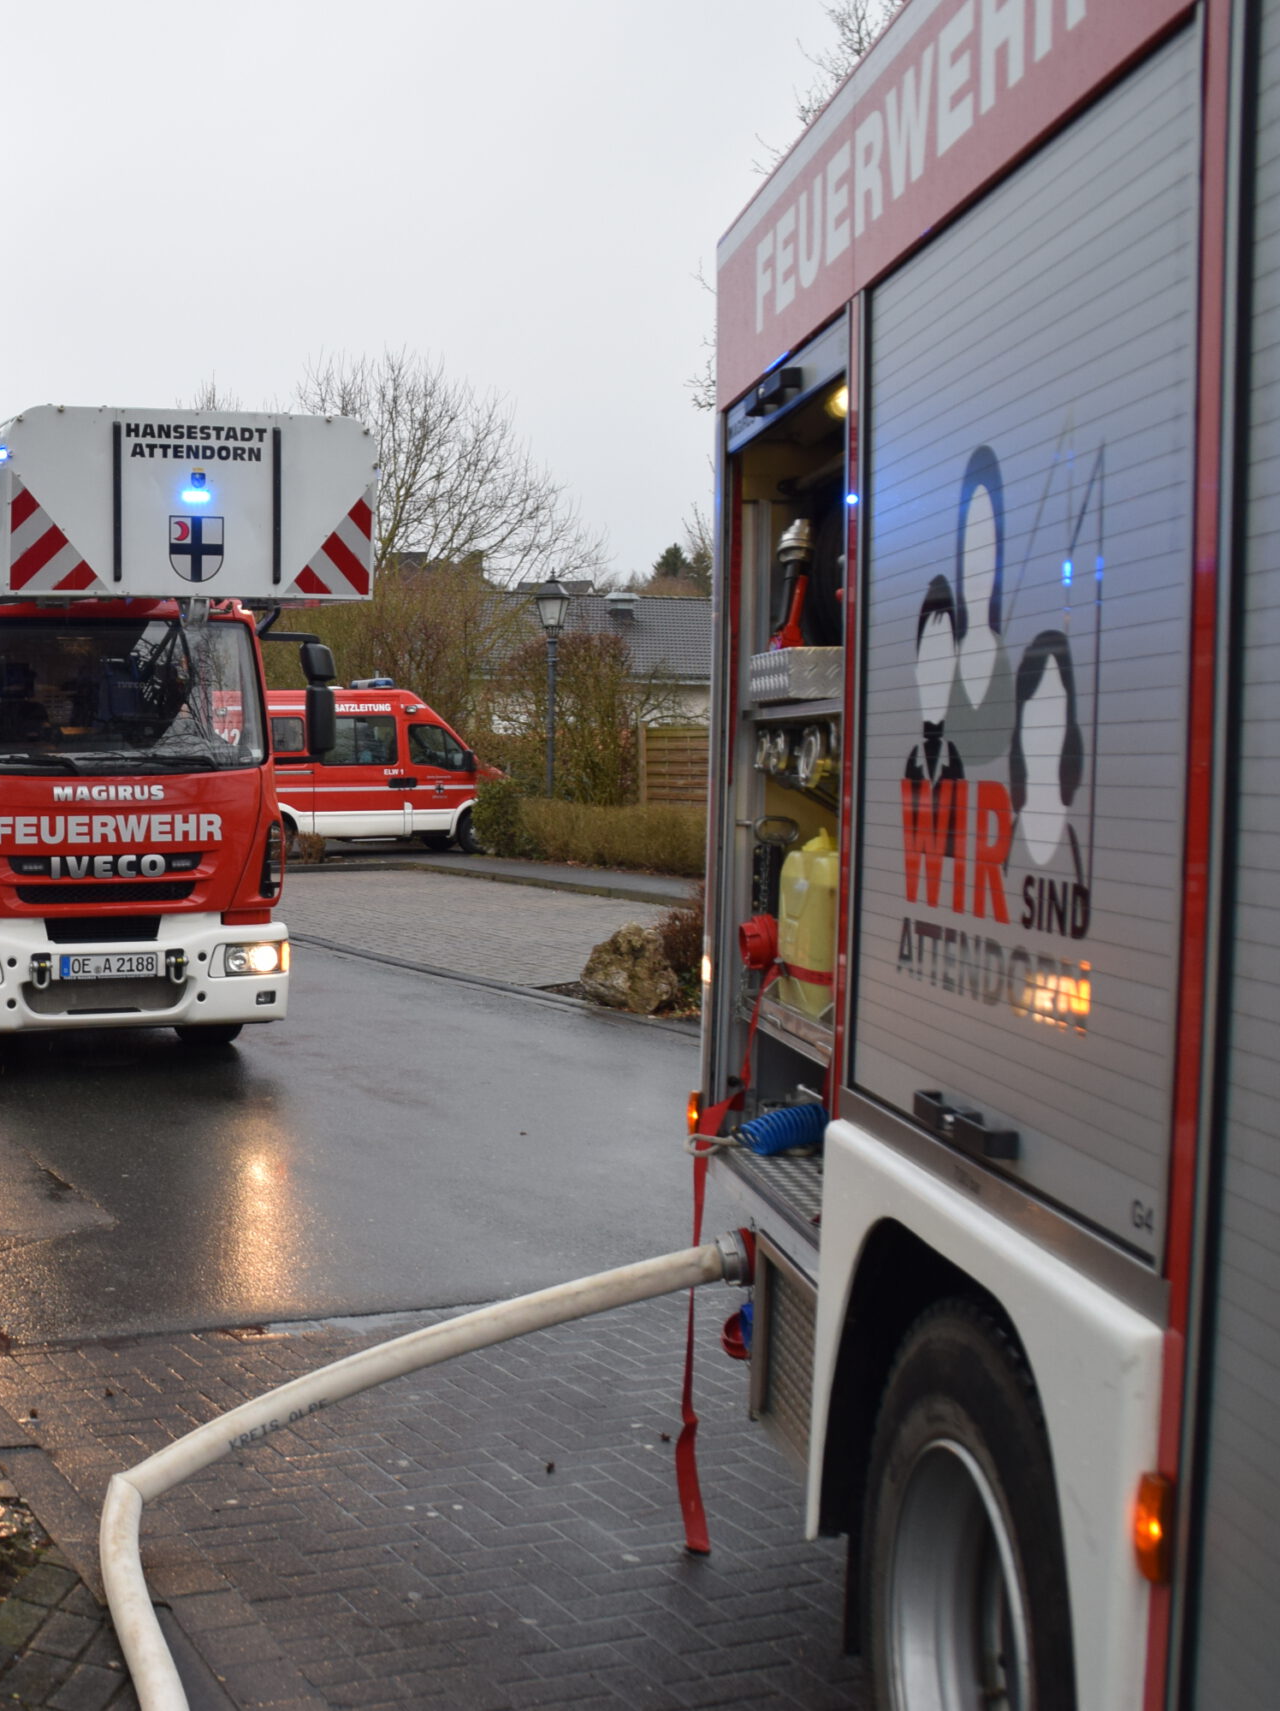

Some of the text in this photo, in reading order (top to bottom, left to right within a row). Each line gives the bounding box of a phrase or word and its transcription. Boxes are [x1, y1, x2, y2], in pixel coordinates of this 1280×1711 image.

[125, 423, 267, 442] HANSESTADT
[130, 443, 262, 462] ATTENDORN
[334, 704, 392, 712] SATZLEITUNG
[53, 785, 165, 801] MAGIRUS
[901, 779, 1010, 924] WIR
[50, 854, 166, 879] IVECO
[1021, 874, 1091, 940] SIND
[71, 956, 155, 974] OE A 2188
[897, 917, 1092, 1037] ATTENDORN
[1131, 1199, 1154, 1236] G4
[228, 1419, 280, 1451] KREIS
